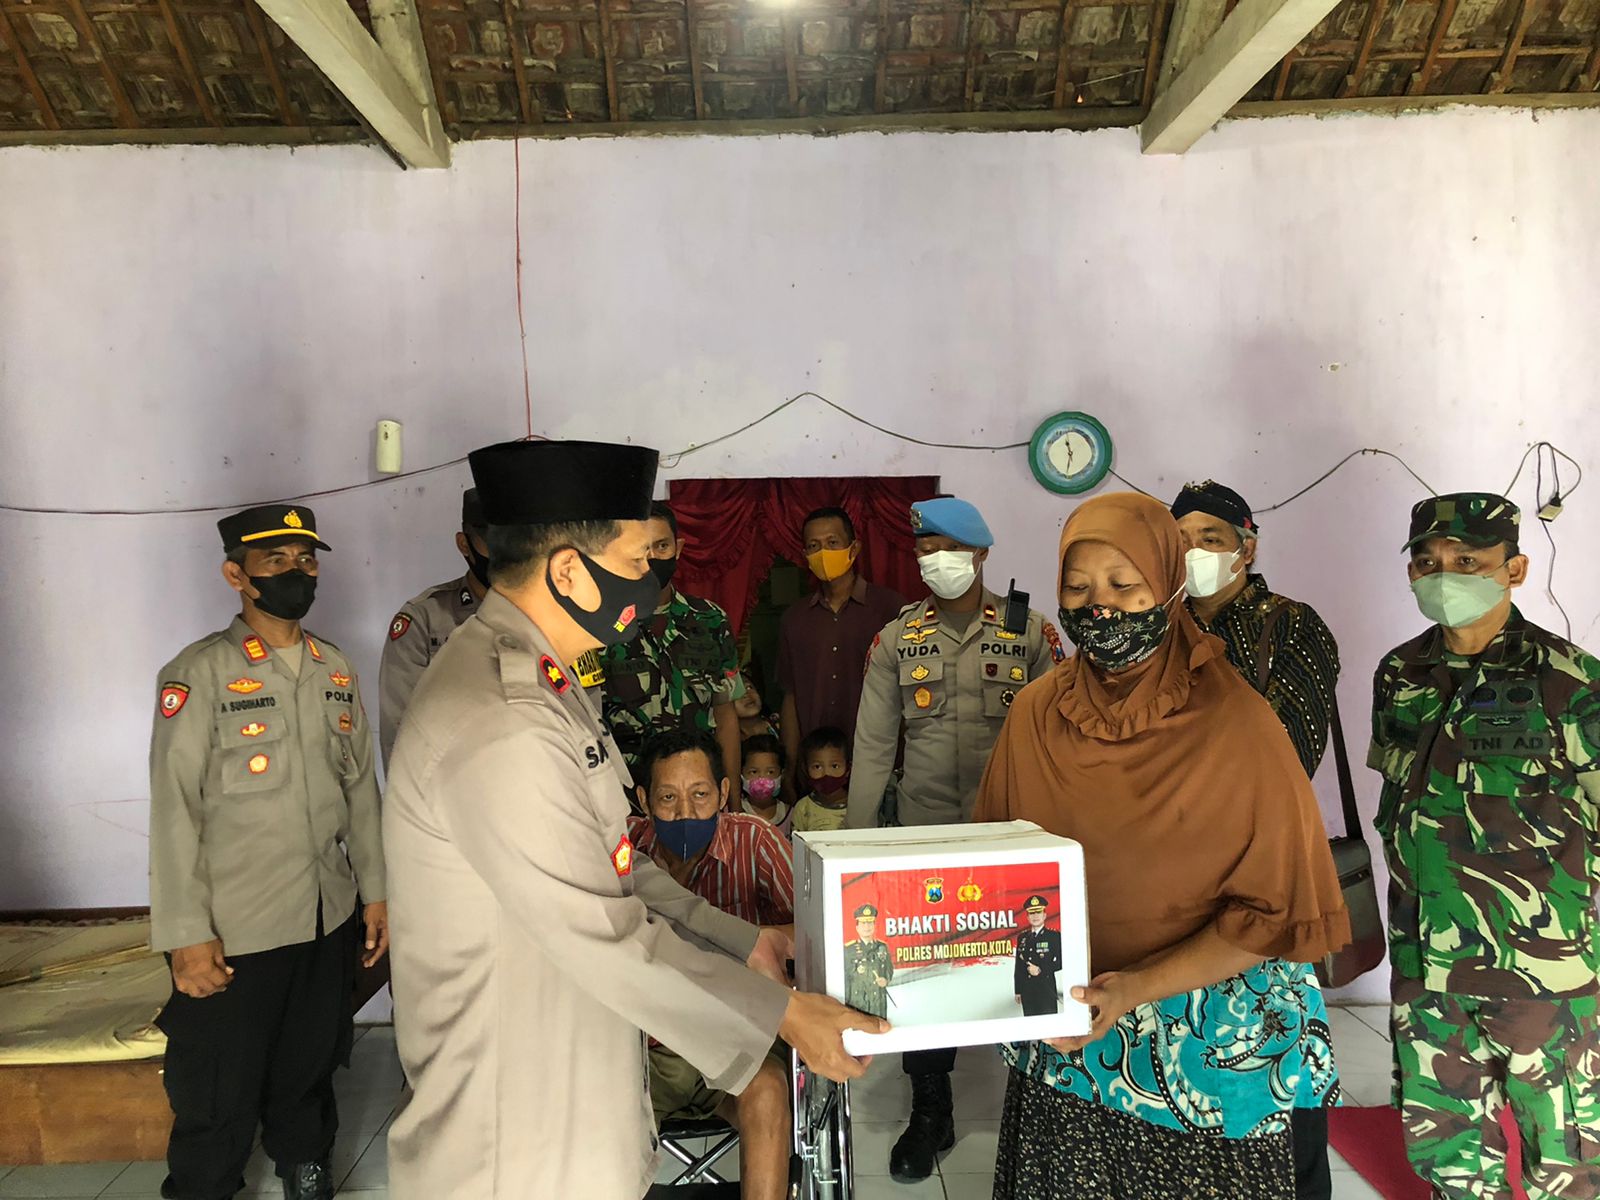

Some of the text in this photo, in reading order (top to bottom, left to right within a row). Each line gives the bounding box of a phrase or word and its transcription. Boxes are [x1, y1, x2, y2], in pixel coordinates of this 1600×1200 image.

[898, 644, 940, 659] YUDA
[981, 643, 1026, 658] POLRI
[1469, 736, 1544, 751] TNI AD
[885, 909, 1018, 936] BHAKTI SOSIAL
[896, 939, 1013, 962] POLRES MOJOKERTO KOTA
